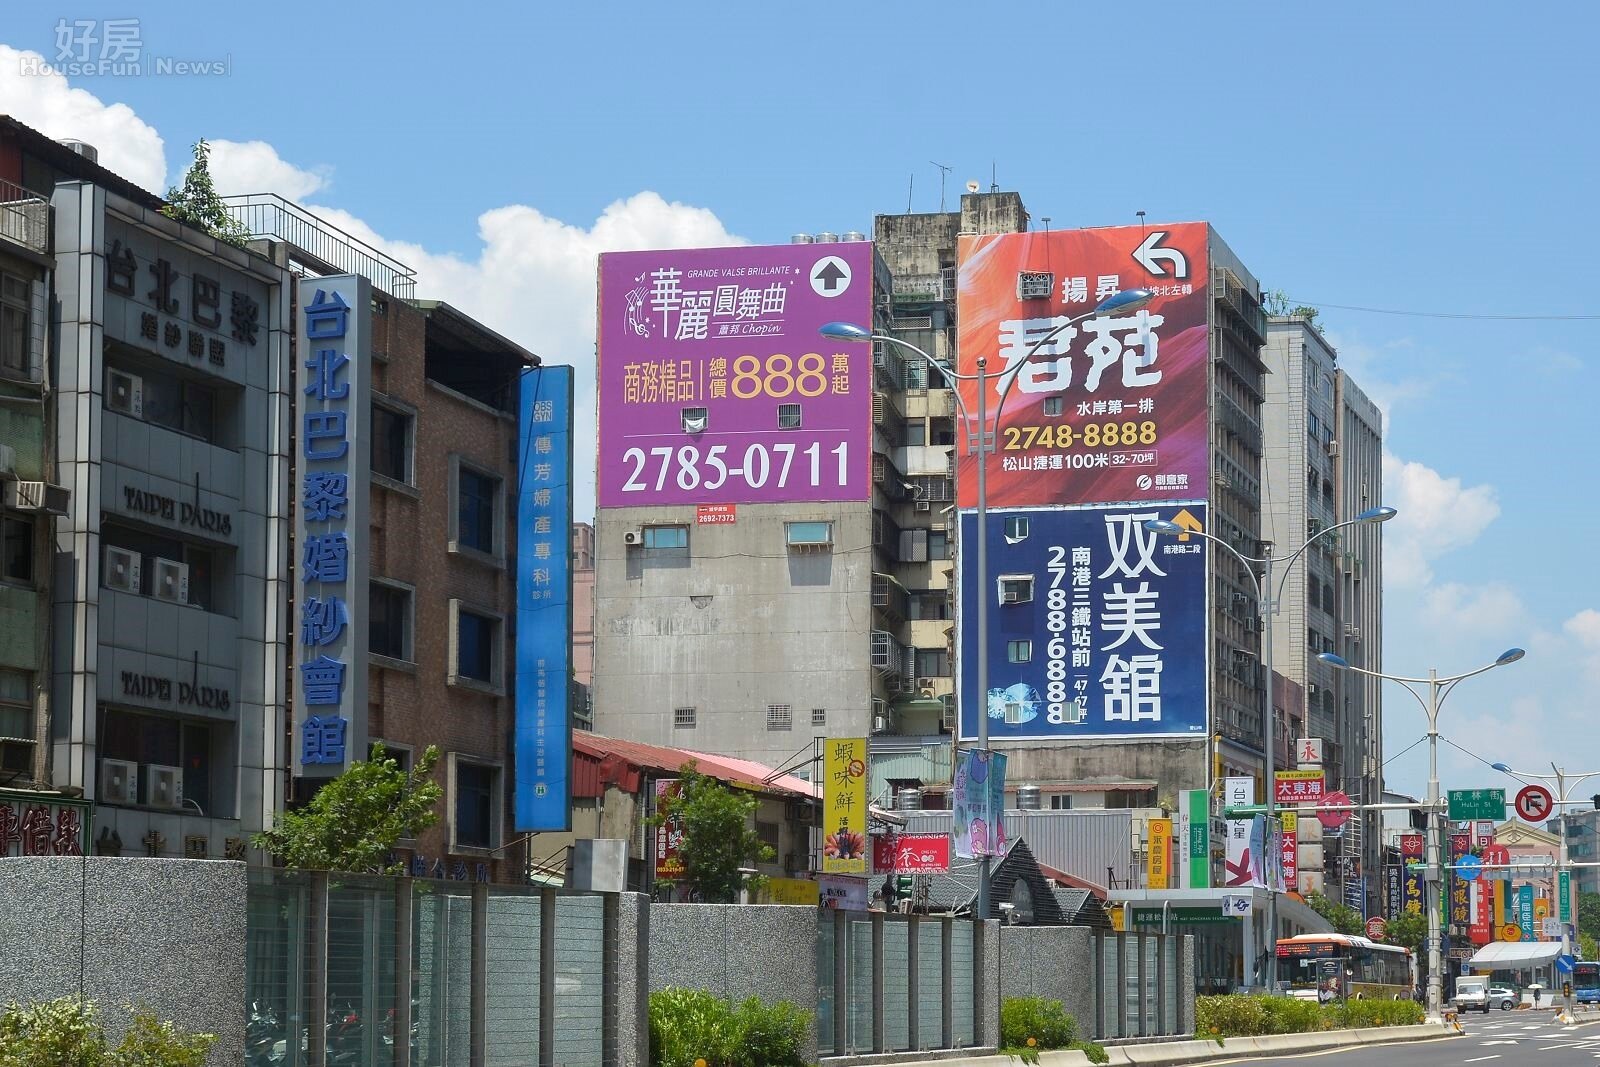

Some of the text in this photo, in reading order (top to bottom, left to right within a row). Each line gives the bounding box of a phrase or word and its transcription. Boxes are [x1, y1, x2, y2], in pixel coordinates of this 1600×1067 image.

[687, 266, 790, 278] GRANDE VALSE BRILLANTE
[106, 239, 260, 346] 台北巴黎
[650, 267, 786, 340] 華麗圓舞曲
[1142, 284, 1193, 297] 坡北左轉
[742, 323, 781, 336] Chopin
[624, 359, 694, 403] 商務精品
[709, 357, 727, 399] 總價
[731, 352, 828, 398] 888
[831, 353, 850, 395] 萬起
[1076, 398, 1154, 417] 水岸第一排
[1003, 421, 1157, 450] 2748-8888
[621, 441, 848, 492] 2785-0711
[124, 485, 176, 520] TAIPEI
[301, 288, 351, 766] 台北巴黎婚紗會館
[1163, 544, 1201, 555] 南港路二段
[1071, 547, 1091, 668] 南港三鐵站前
[121, 670, 172, 700] TAIPEI
[1300, 741, 1319, 761] 永
[834, 742, 856, 813] 蝦味鮮
[1278, 781, 1321, 795] 大東海
[1453, 790, 1500, 801] 虎林街
[1282, 835, 1295, 879] 大東海
[1453, 852, 1470, 923] 島眼鏡
[1137, 912, 1178, 922] 捷運松站
[1368, 920, 1385, 936] 藥
